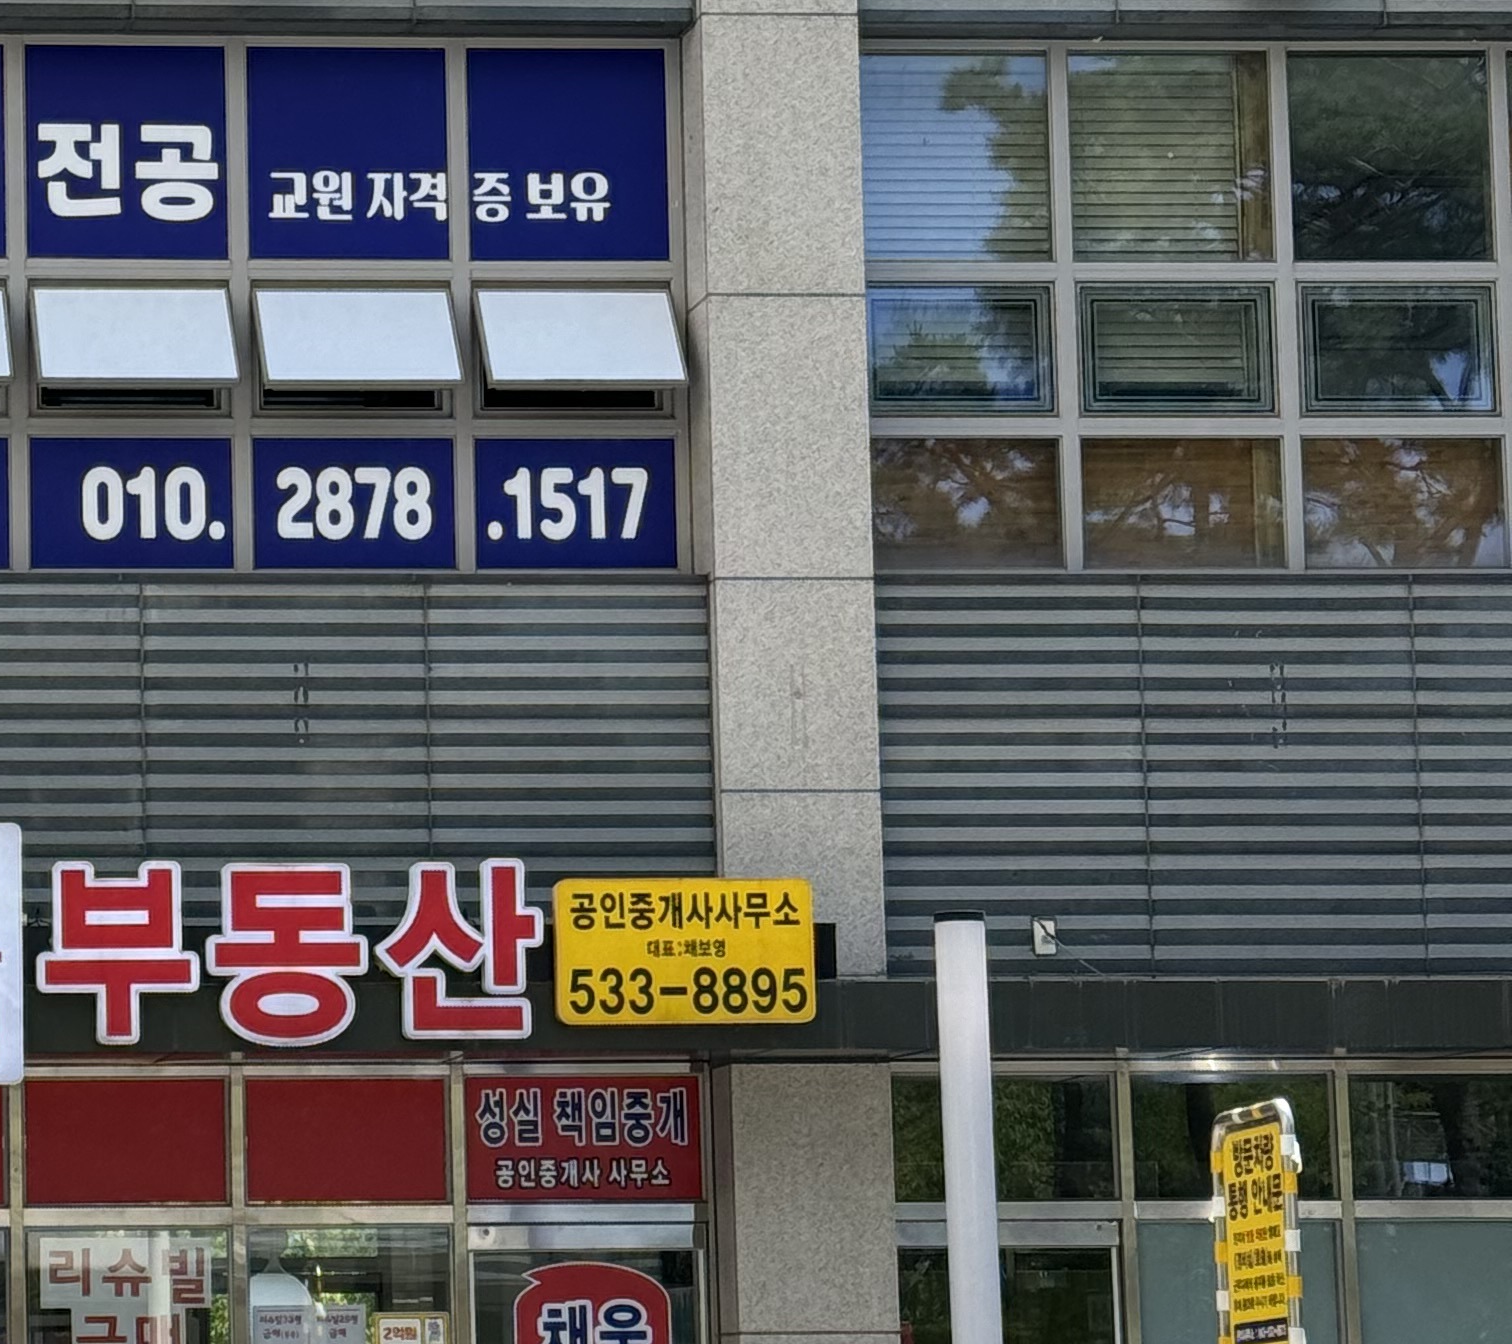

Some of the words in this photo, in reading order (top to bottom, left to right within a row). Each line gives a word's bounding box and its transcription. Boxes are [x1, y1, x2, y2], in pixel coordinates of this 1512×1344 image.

[37, 123, 220, 221] 전공
[267, 171, 354, 222] 교원
[525, 171, 612, 222] 보유
[569, 891, 801, 931] 공인중개사사무소
[36, 857, 543, 1047] 부동산
[569, 967, 808, 1016] 533-8895
[477, 1088, 543, 1147] 성실
[554, 1088, 688, 1147] 책임중개
[495, 1159, 600, 1188] 공인중개사
[608, 1159, 671, 1186] 사무소
[49, 1247, 205, 1305] 리슈빌
